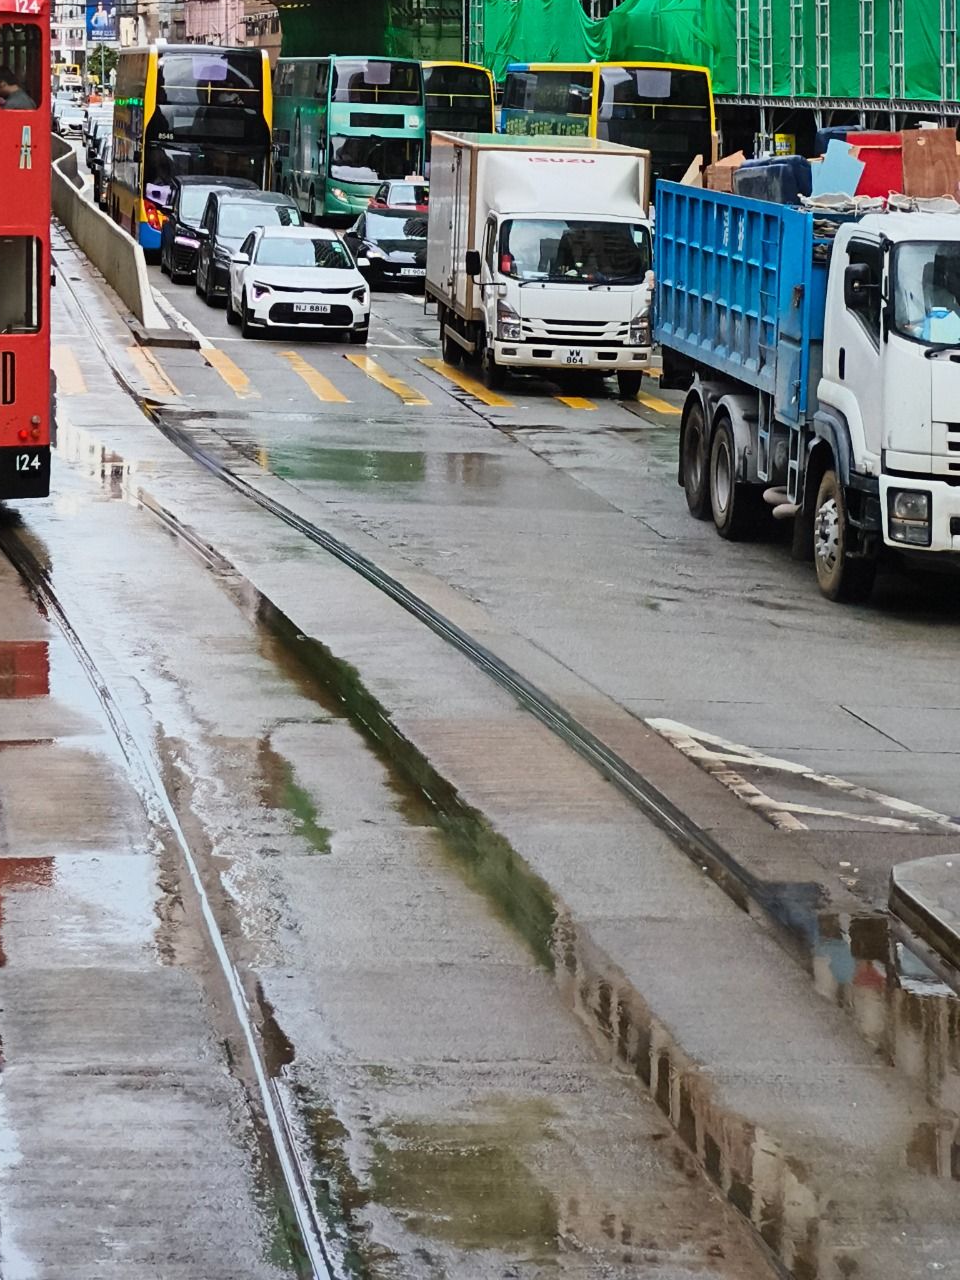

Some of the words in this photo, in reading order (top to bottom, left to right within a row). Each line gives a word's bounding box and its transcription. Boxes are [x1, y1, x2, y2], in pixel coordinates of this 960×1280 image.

[309, 305, 329, 313] 8816
[566, 356, 584, 364] 864
[16, 454, 41, 470] 124
